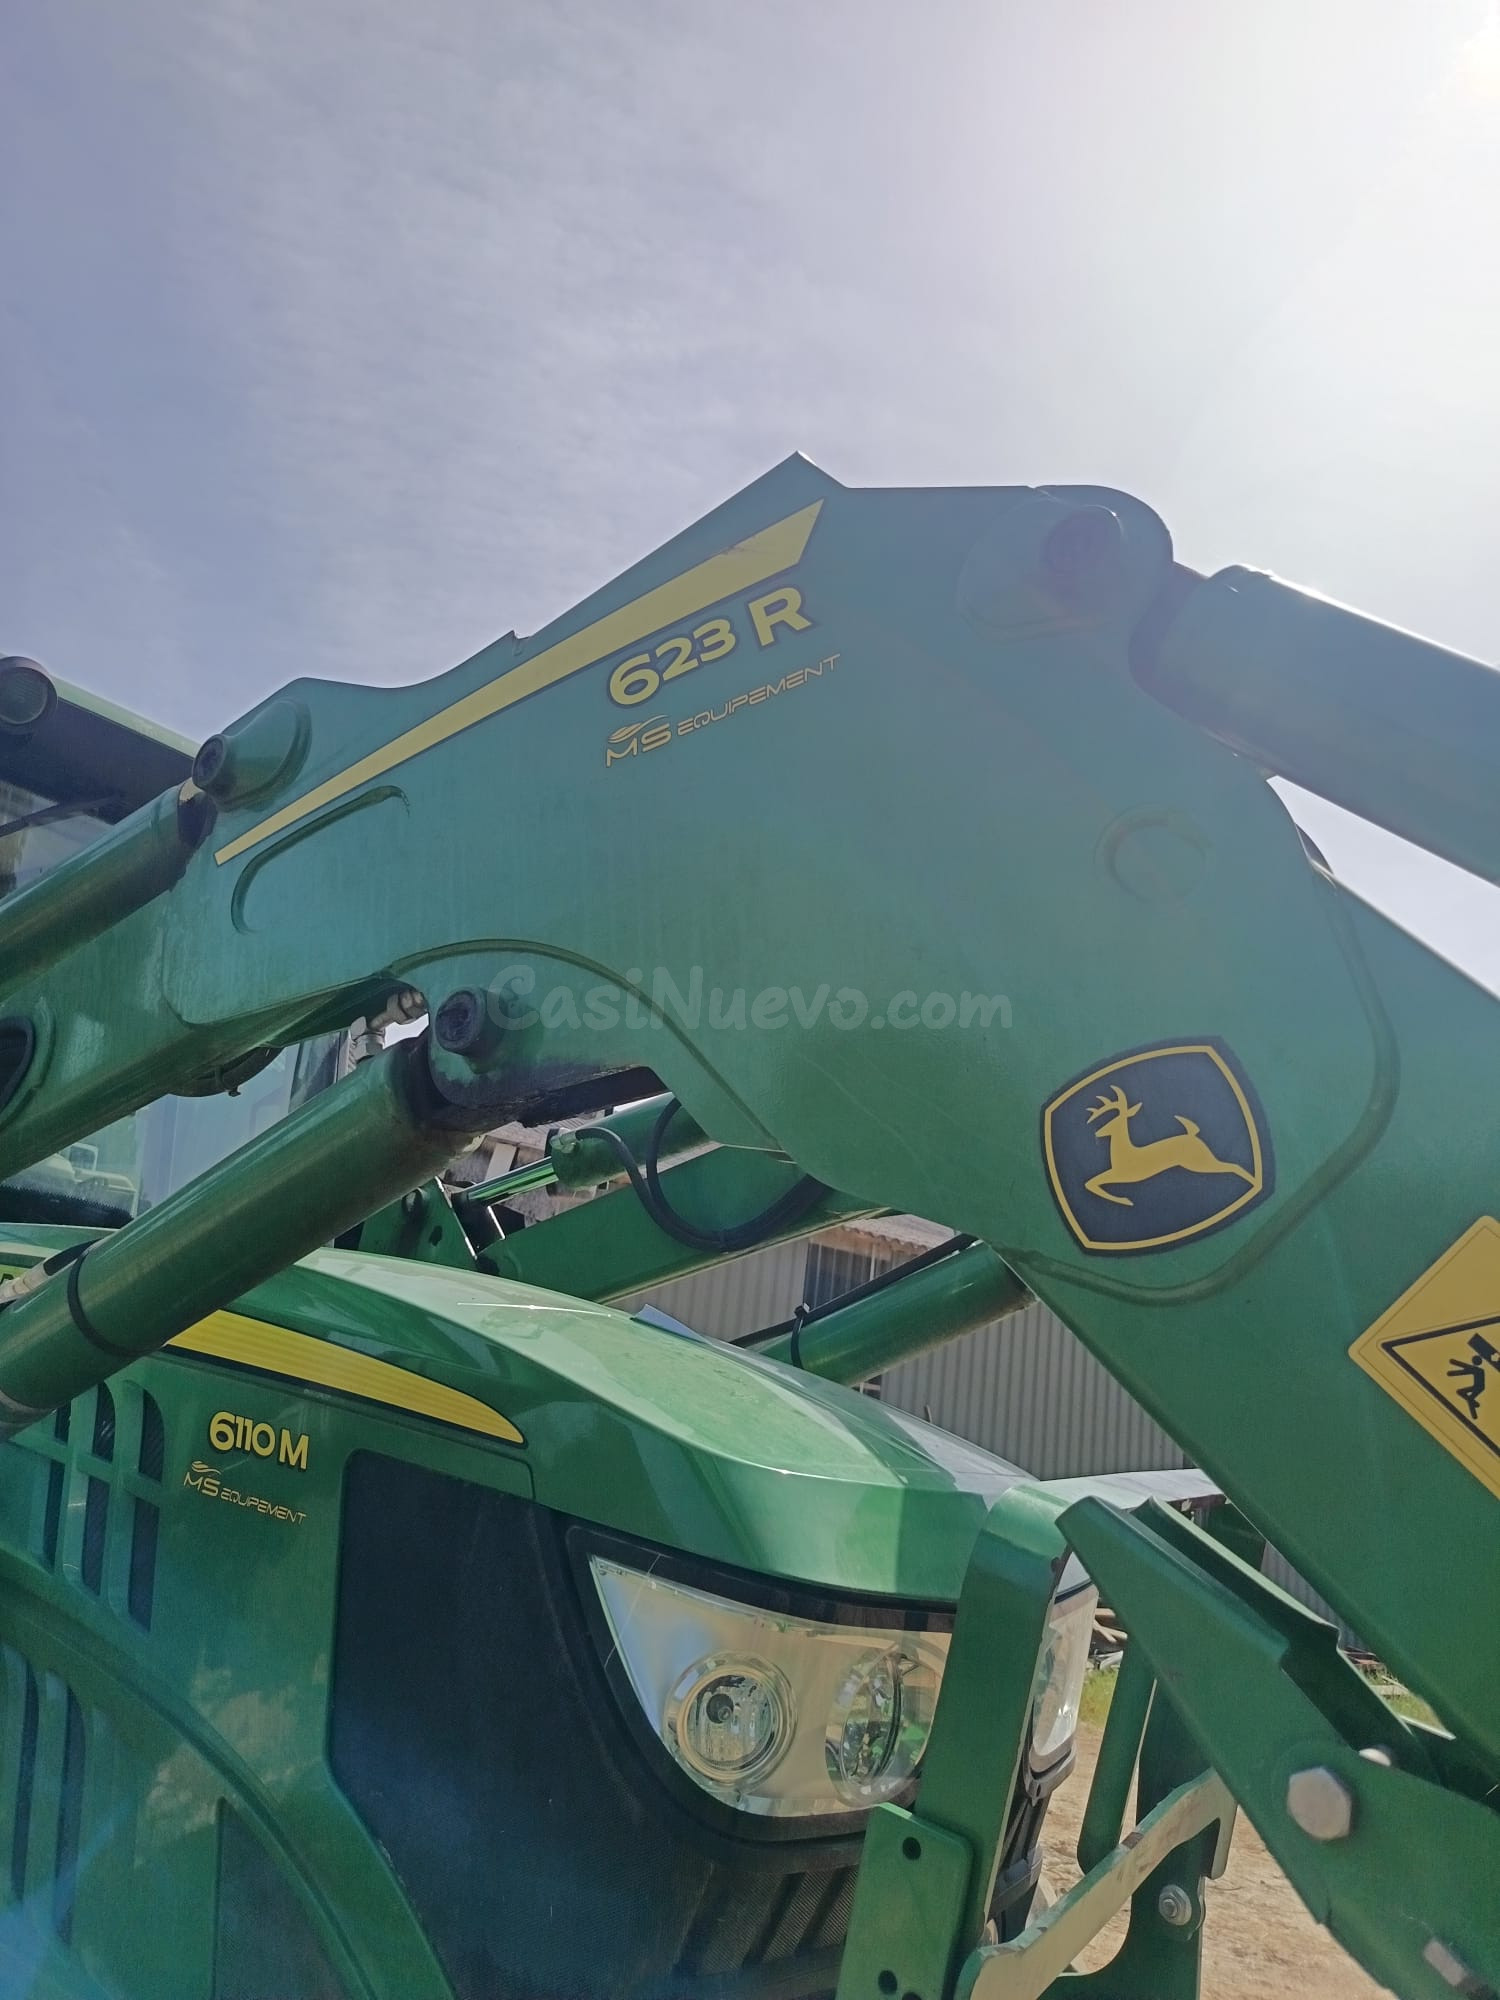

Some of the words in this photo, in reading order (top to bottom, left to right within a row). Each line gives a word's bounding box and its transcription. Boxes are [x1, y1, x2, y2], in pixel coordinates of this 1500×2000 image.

[609, 618, 736, 705] 623
[748, 587, 812, 646] R
[606, 722, 672, 767] MS
[677, 653, 841, 736] EQUIPEMENT
[183, 1472, 221, 1498] MS
[220, 1488, 307, 1524] EQUIPEMENT
